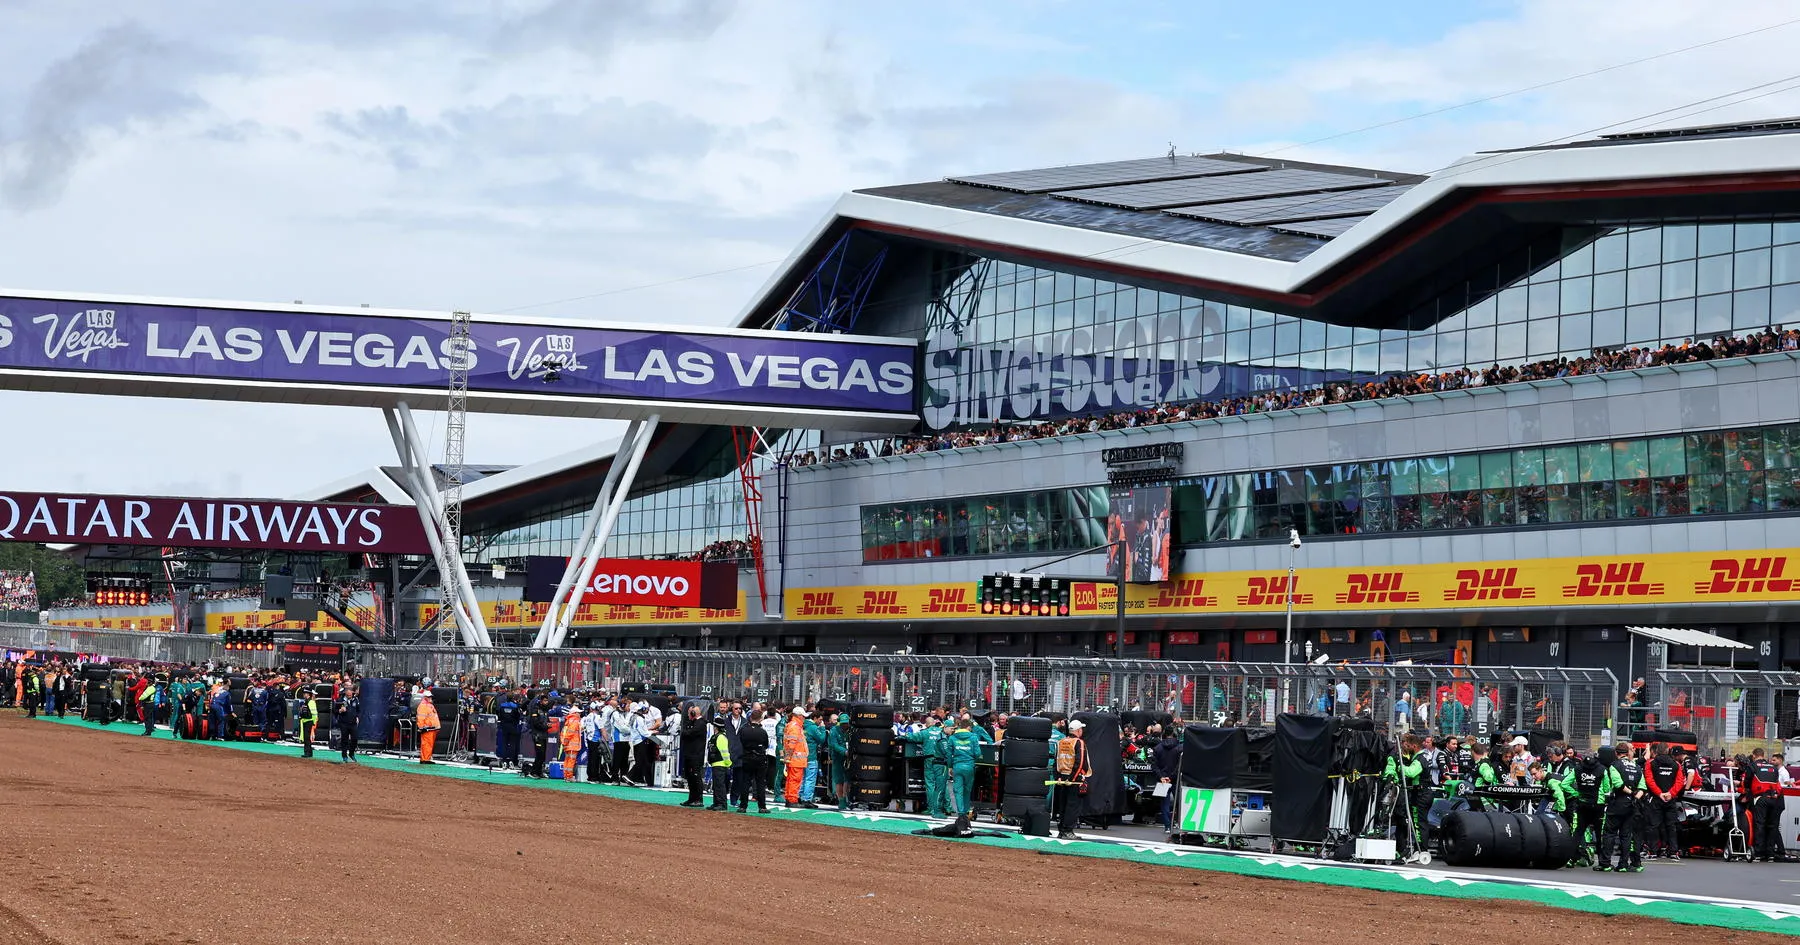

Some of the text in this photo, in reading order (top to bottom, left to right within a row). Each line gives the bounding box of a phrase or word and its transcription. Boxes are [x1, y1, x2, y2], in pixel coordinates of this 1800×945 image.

[89, 311, 112, 326] LAS
[33, 312, 130, 363] Vegas
[146, 322, 478, 371] LAS VEGAS
[549, 336, 571, 350] LAS
[604, 346, 913, 395] LAS VEGAS
[922, 306, 1224, 430] Silverstone
[167, 501, 382, 547] AIRWAYS
[1455, 567, 1523, 601] DHL
[1576, 562, 1651, 597] DHL
[1709, 557, 1792, 594] DHL
[1157, 579, 1209, 608] DHL
[1247, 575, 1303, 606] DHL
[1346, 572, 1408, 604] DHL
[803, 592, 837, 616] DHL
[863, 590, 900, 614] DHL
[928, 588, 968, 613] DHL
[1550, 642, 1560, 657] 07
[1760, 640, 1771, 656] 05
[584, 680, 595, 688] 16
[700, 685, 712, 694] 10
[757, 688, 769, 697] 55
[835, 692, 846, 701] 12
[911, 696, 925, 705] 22
[969, 699, 977, 708] 6
[1478, 722, 1488, 734] 5
[1182, 788, 1215, 832] 27
